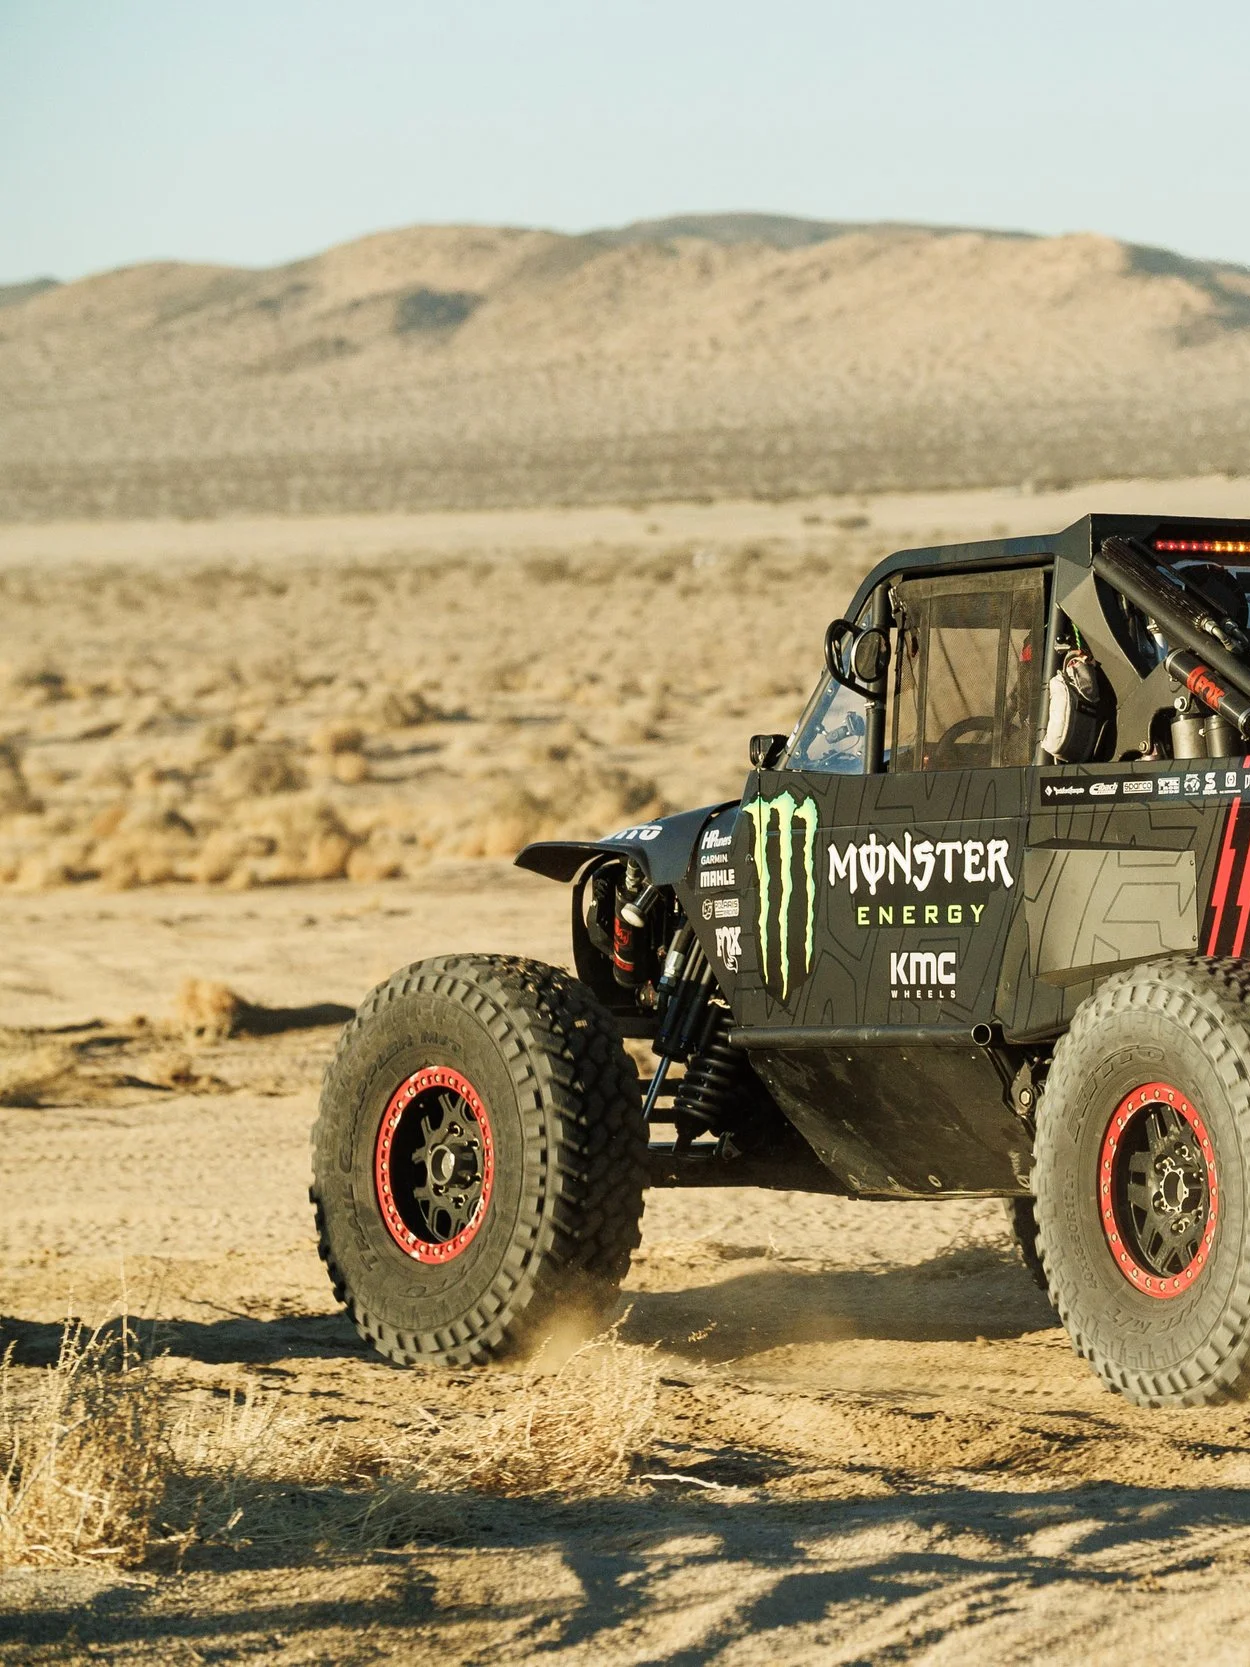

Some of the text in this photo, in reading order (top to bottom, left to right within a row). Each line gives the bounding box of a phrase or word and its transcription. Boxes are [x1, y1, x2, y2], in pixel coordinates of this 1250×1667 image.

[701, 854, 728, 865] GARMIN
[828, 833, 1014, 895] MONSTER
[700, 869, 735, 887] MAHLE
[857, 904, 985, 926] ENERGY
[715, 926, 742, 970] FOX
[890, 989, 956, 999] WHEELS
